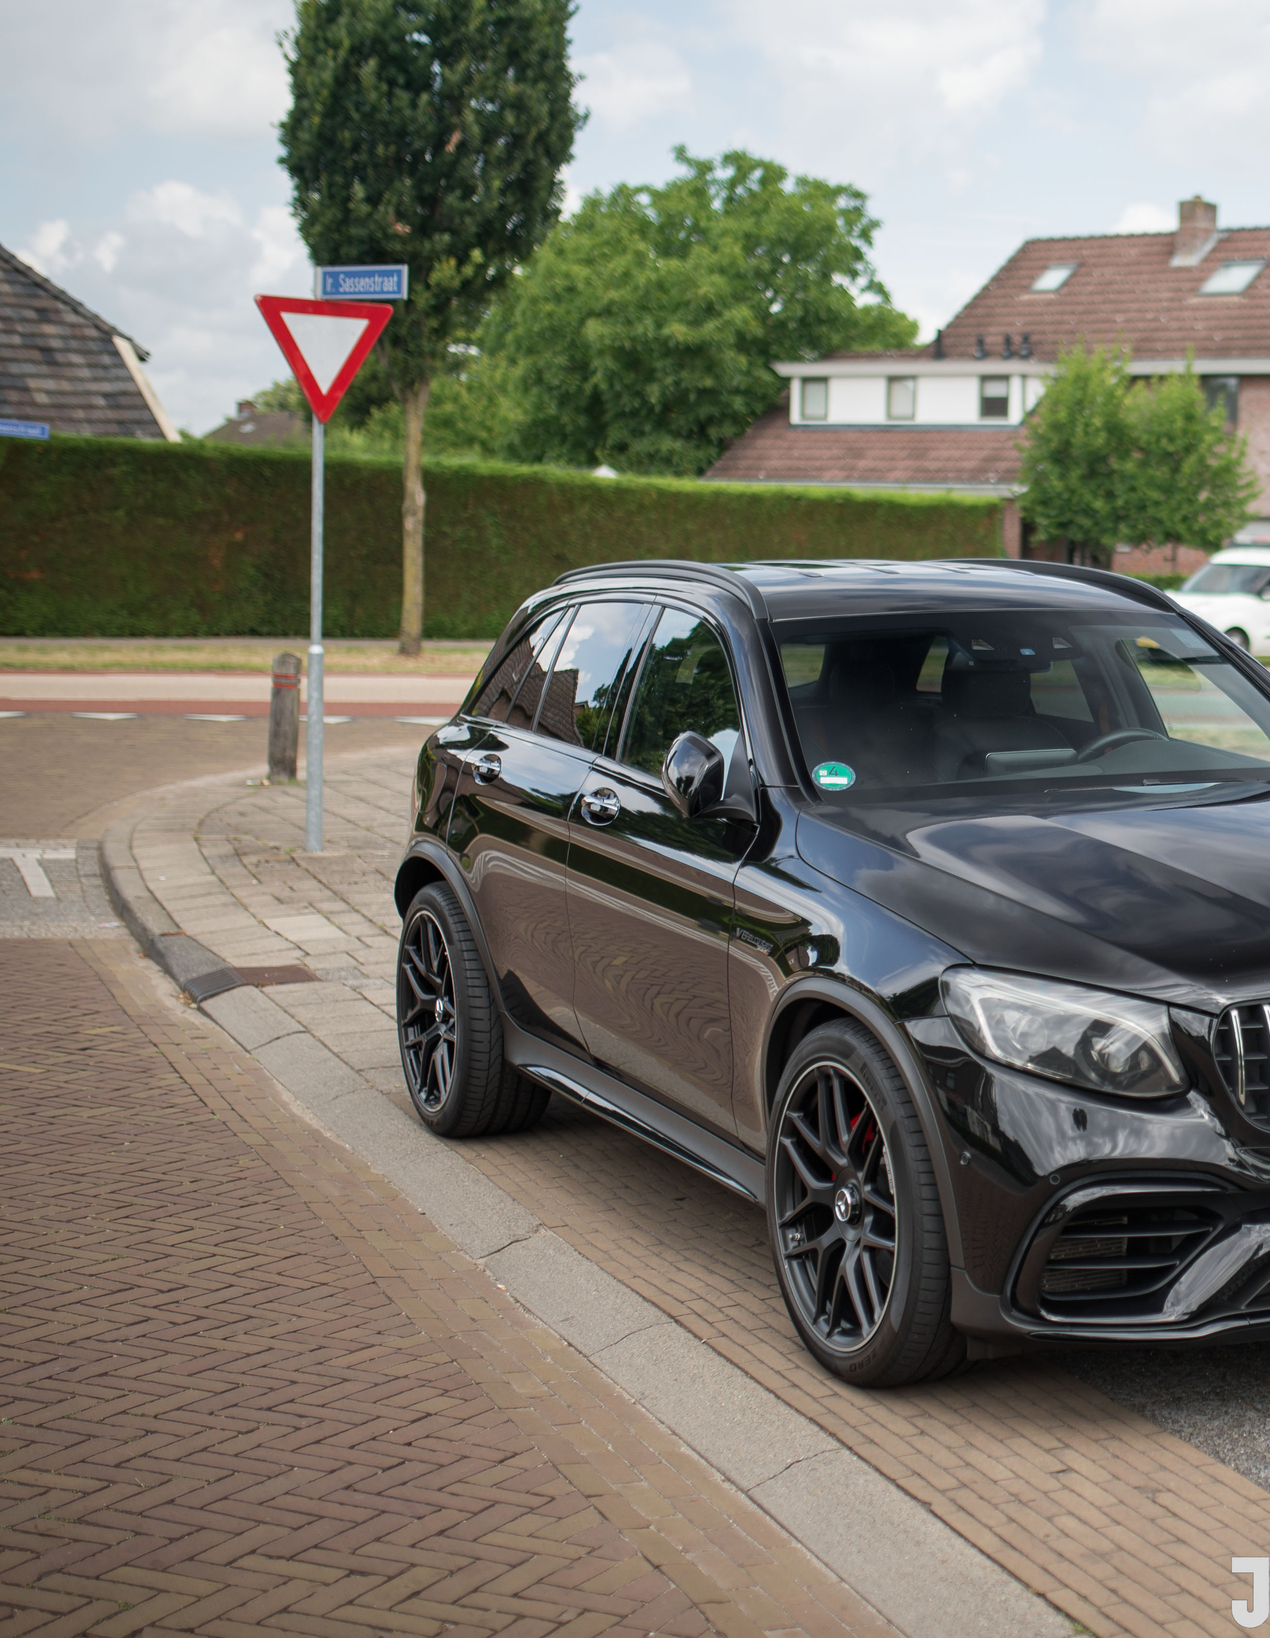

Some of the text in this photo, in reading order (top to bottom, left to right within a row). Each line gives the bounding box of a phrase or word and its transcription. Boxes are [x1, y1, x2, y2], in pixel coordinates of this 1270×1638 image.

[325, 273, 398, 293] Ir. Sassenstraat
[829, 766, 839, 777] 4
